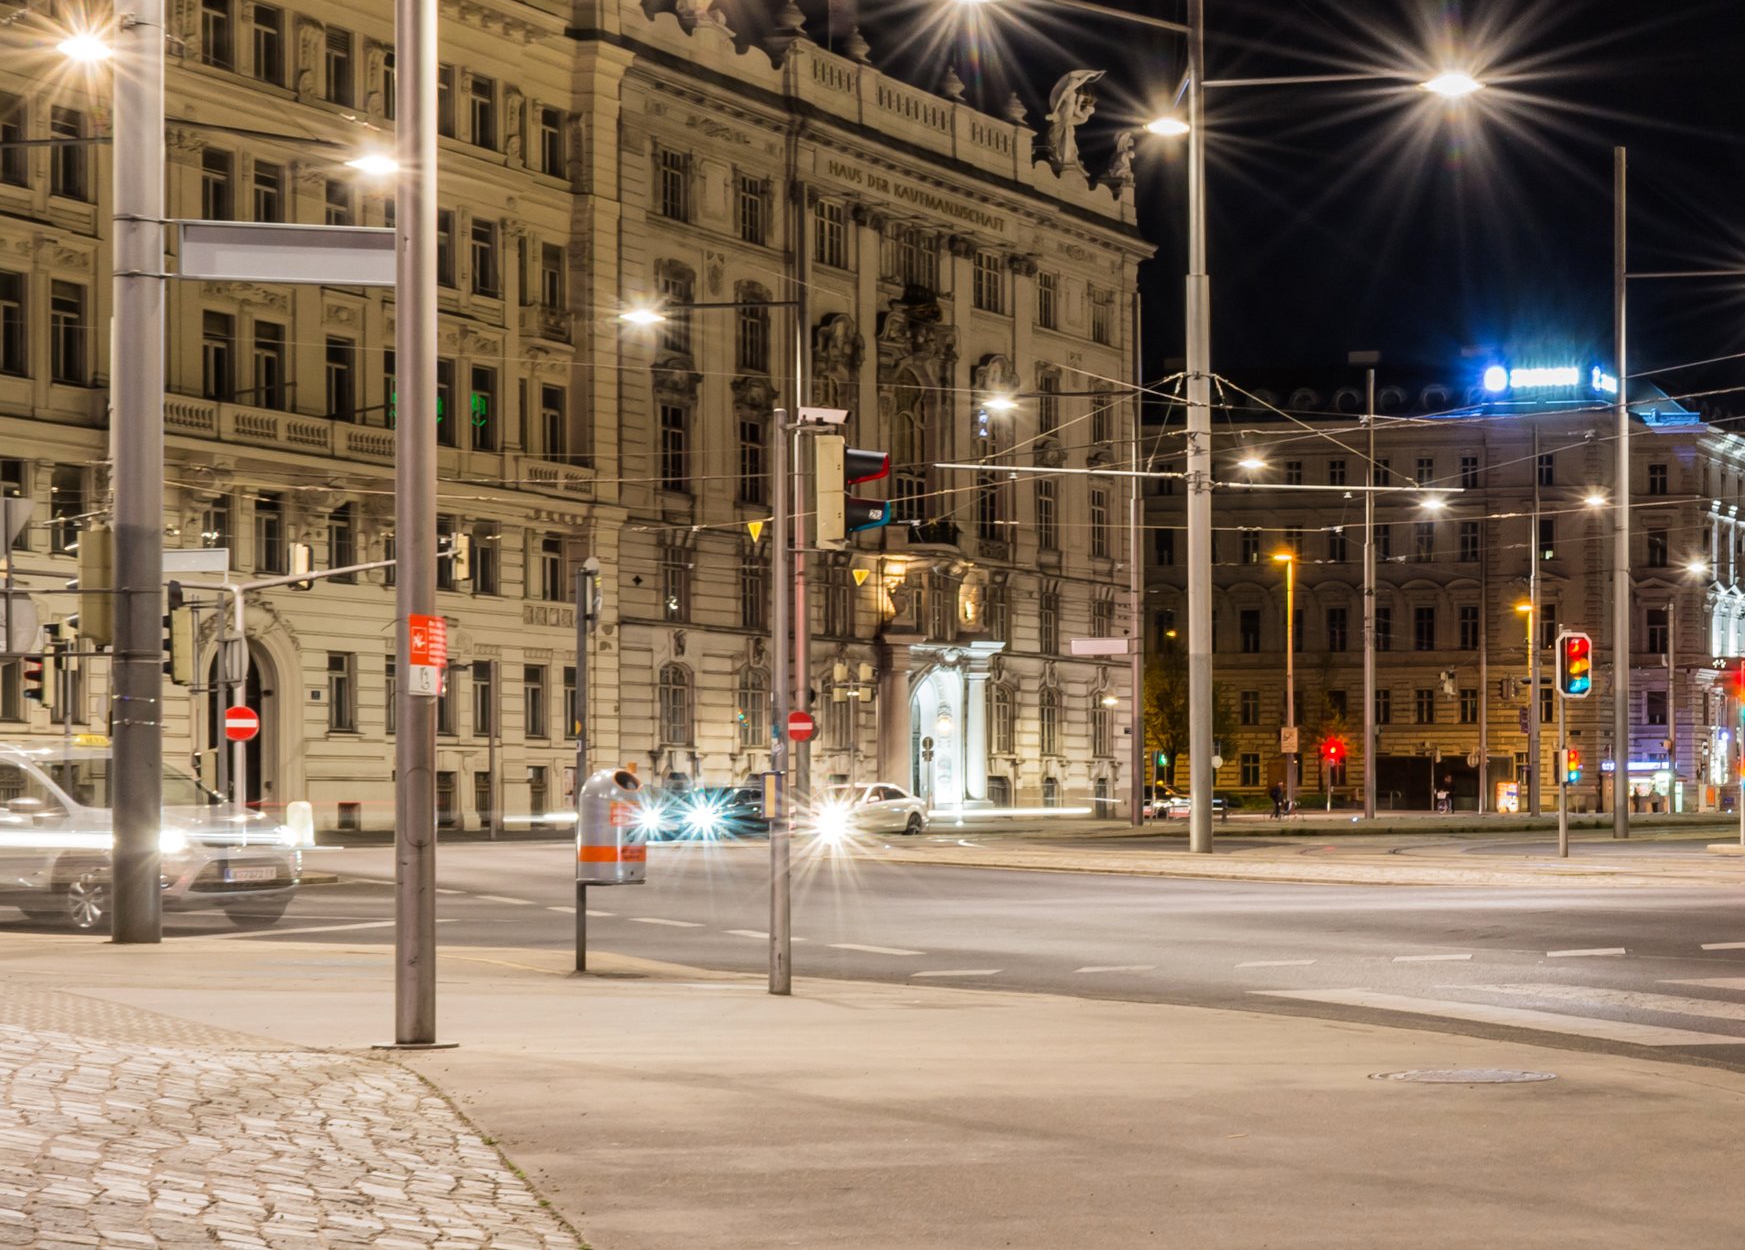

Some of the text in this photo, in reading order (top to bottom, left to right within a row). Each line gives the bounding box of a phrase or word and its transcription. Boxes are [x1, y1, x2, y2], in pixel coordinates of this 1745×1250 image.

[828, 160, 1006, 232] HAUS DER KAUFMANNSCHAFT
